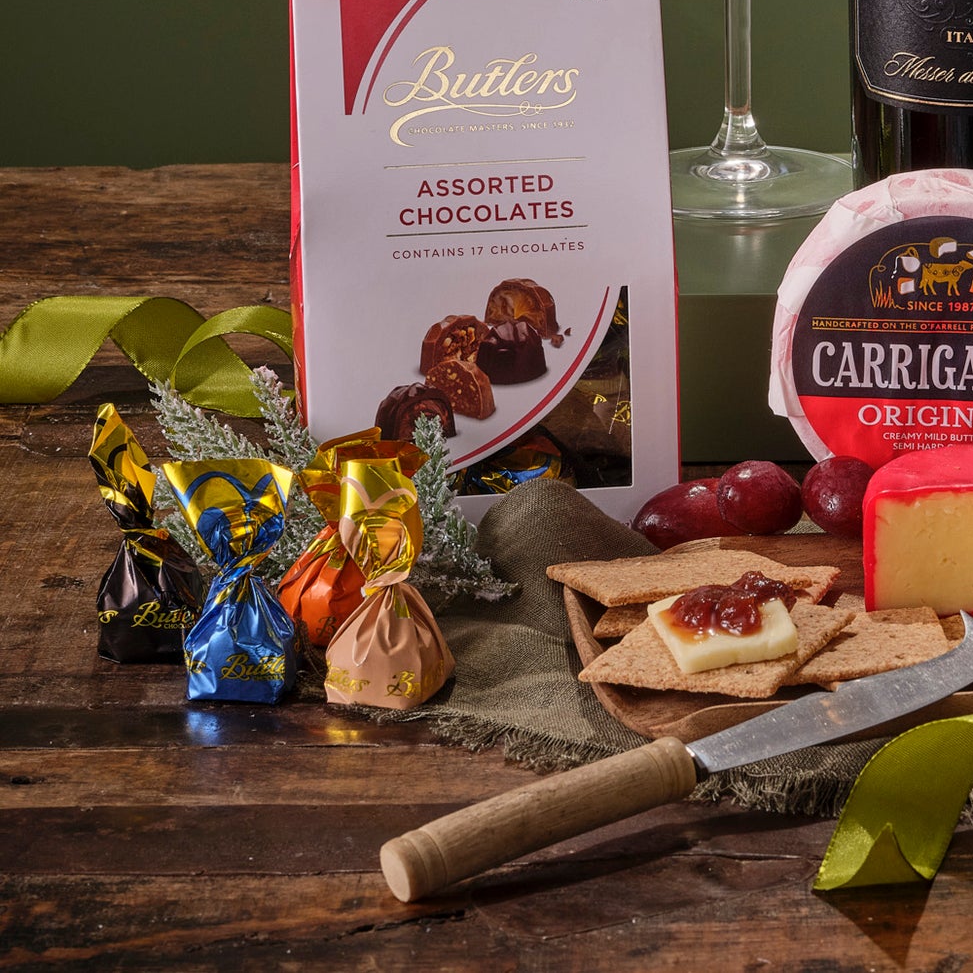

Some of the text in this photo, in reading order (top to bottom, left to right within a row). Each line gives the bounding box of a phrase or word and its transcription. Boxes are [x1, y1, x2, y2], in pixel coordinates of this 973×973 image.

[883, 51, 955, 83] Messer
[383, 45, 580, 113] Butlers
[408, 126, 465, 135] CHOCOLATE
[521, 122, 547, 130] SINCE
[417, 174, 554, 198] ASSORTED
[399, 200, 574, 226] CHOCOLATES
[392, 240, 585, 260] CONTAINS 17 CHOCOLATES
[907, 301, 943, 312] SINCE
[811, 319, 879, 330] HANDCRAFTED
[882, 322, 897, 330] ON
[900, 322, 917, 331] THE
[920, 323, 966, 332] O'FARRELL
[882, 432, 922, 441] CREAMY
[924, 433, 948, 442] MILD
[892, 442, 915, 451] SEMI
